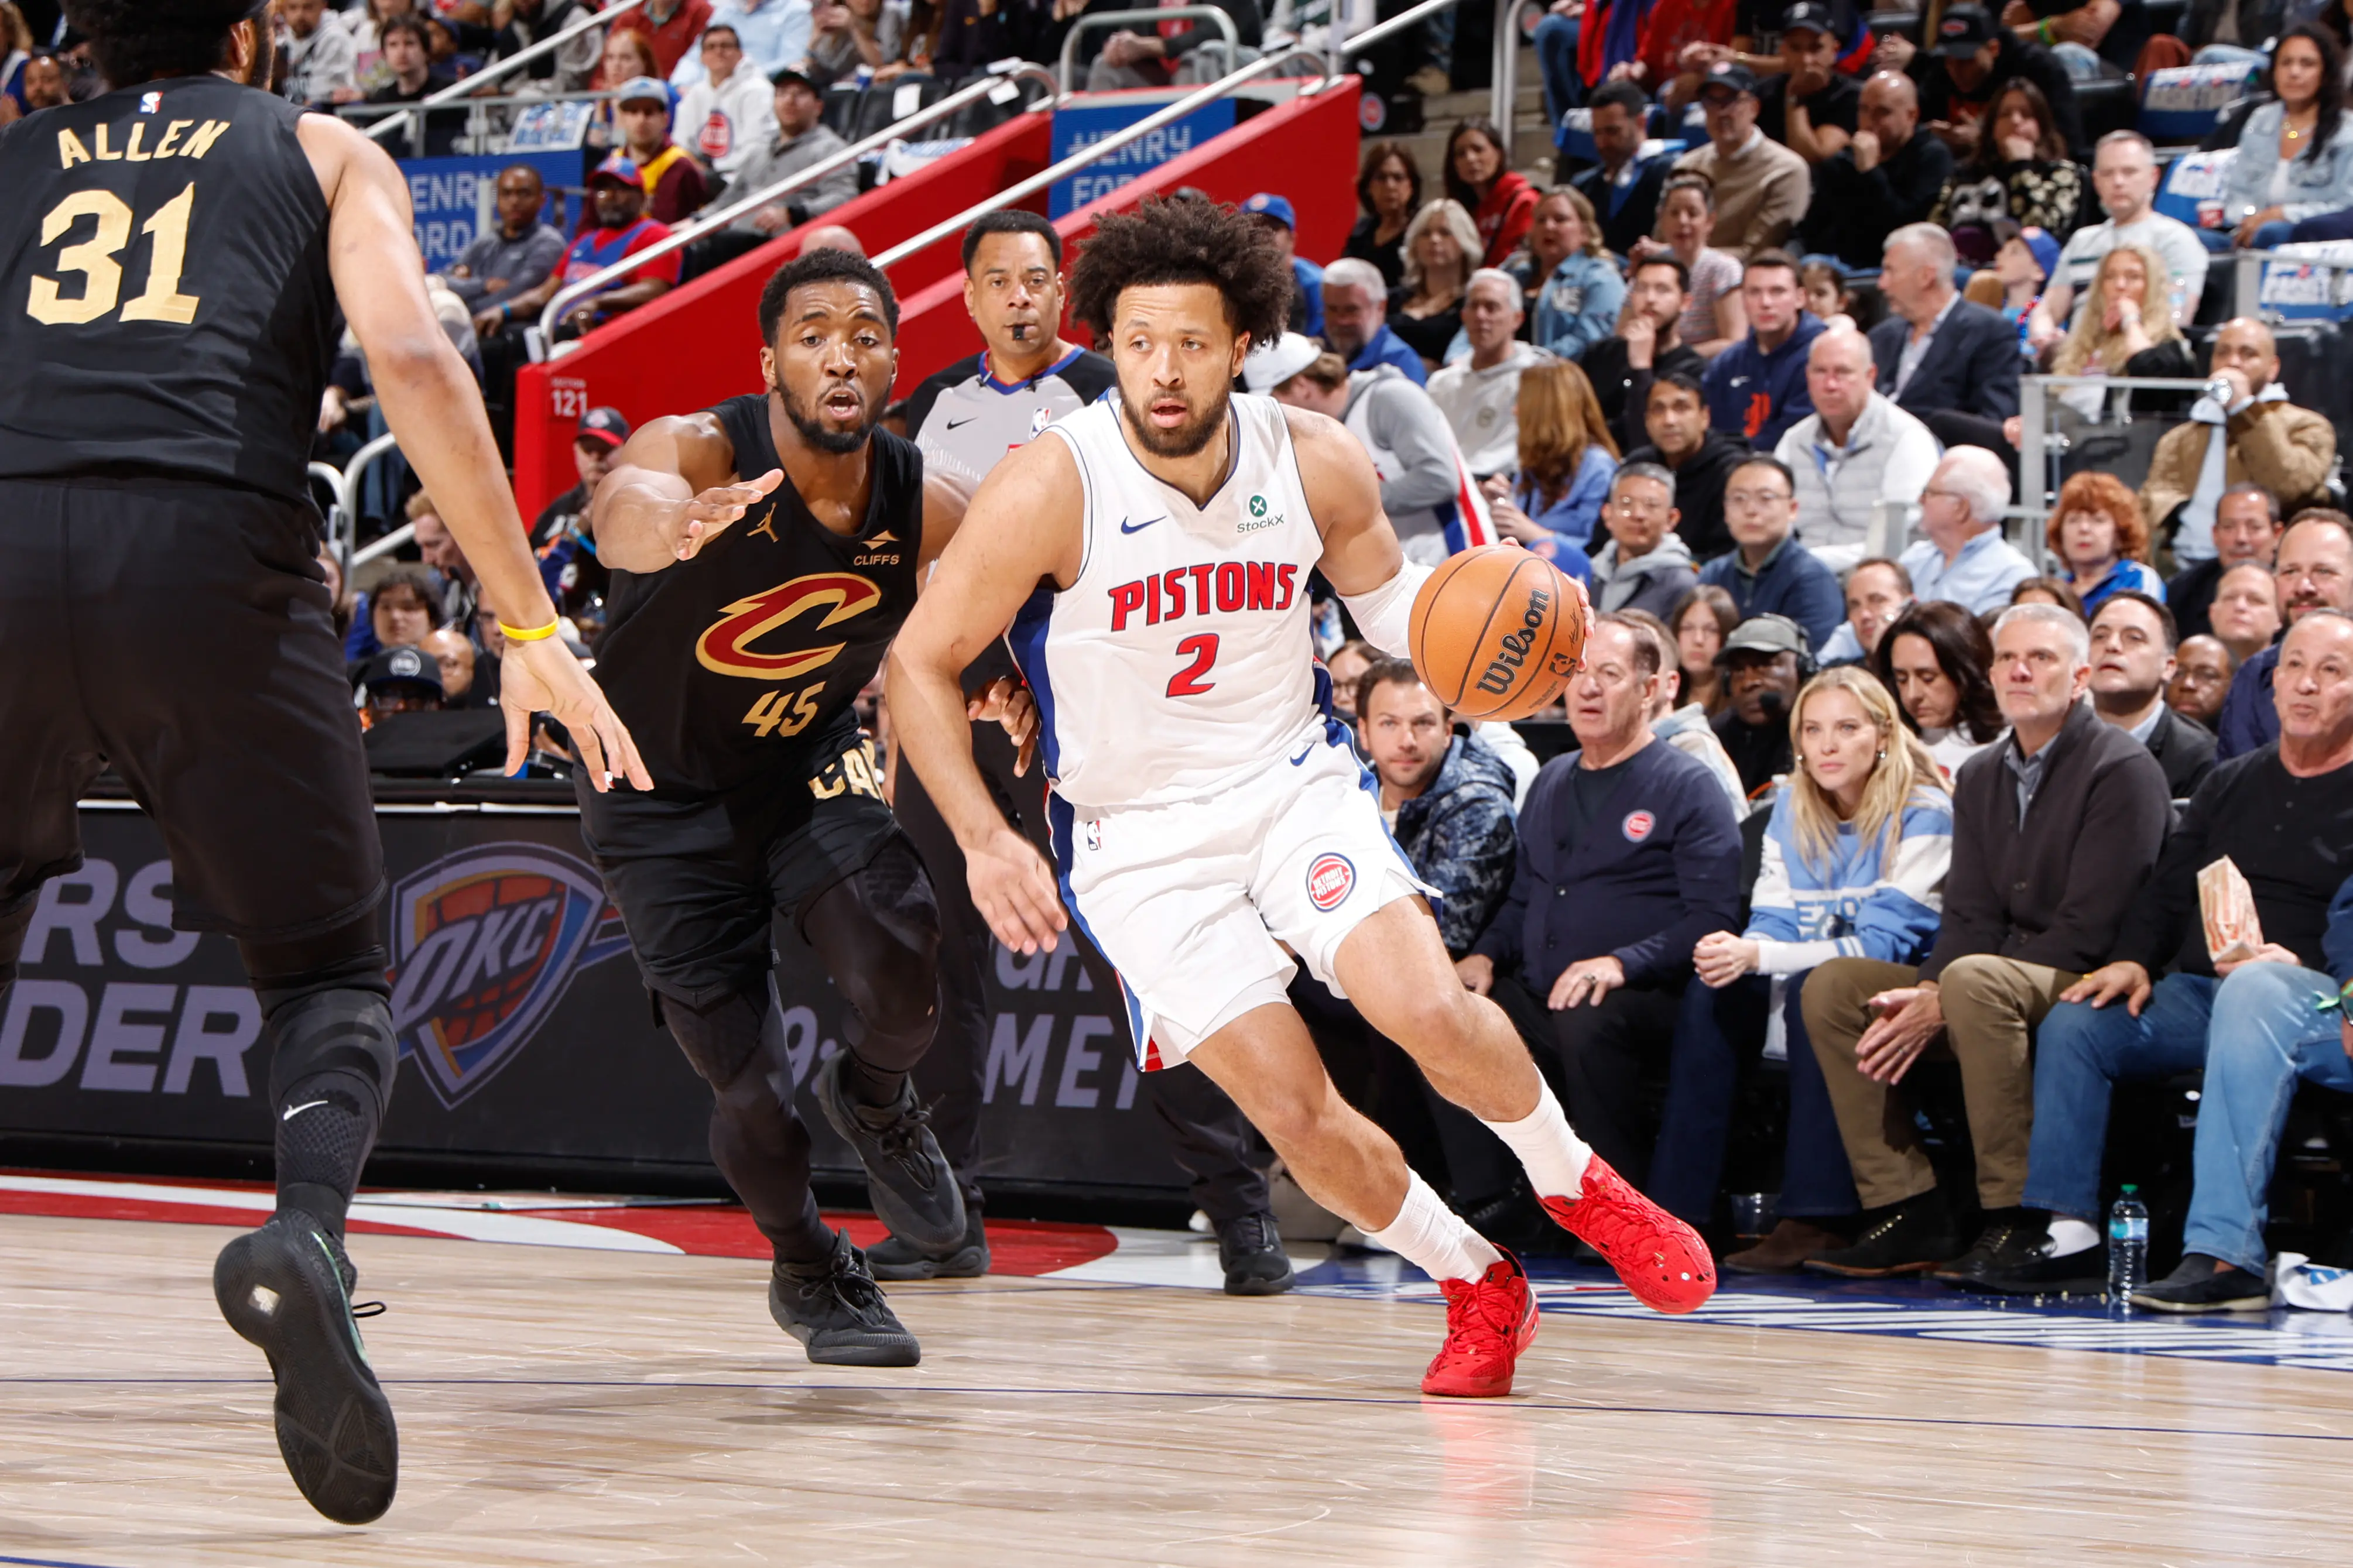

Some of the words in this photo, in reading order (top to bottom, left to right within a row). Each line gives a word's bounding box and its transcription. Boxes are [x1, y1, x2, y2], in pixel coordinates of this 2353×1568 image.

[59, 119, 231, 169] ALLEN
[27, 182, 200, 325] 31
[551, 389, 587, 417] 121
[1237, 513, 1284, 533] StockX
[854, 554, 900, 566] CLIFFS
[1108, 561, 1298, 632] PISTONS
[1166, 633, 1220, 698] 2
[1475, 589, 1549, 695] Wilson
[741, 681, 827, 737] 45
[389, 898, 559, 1034] OKC
